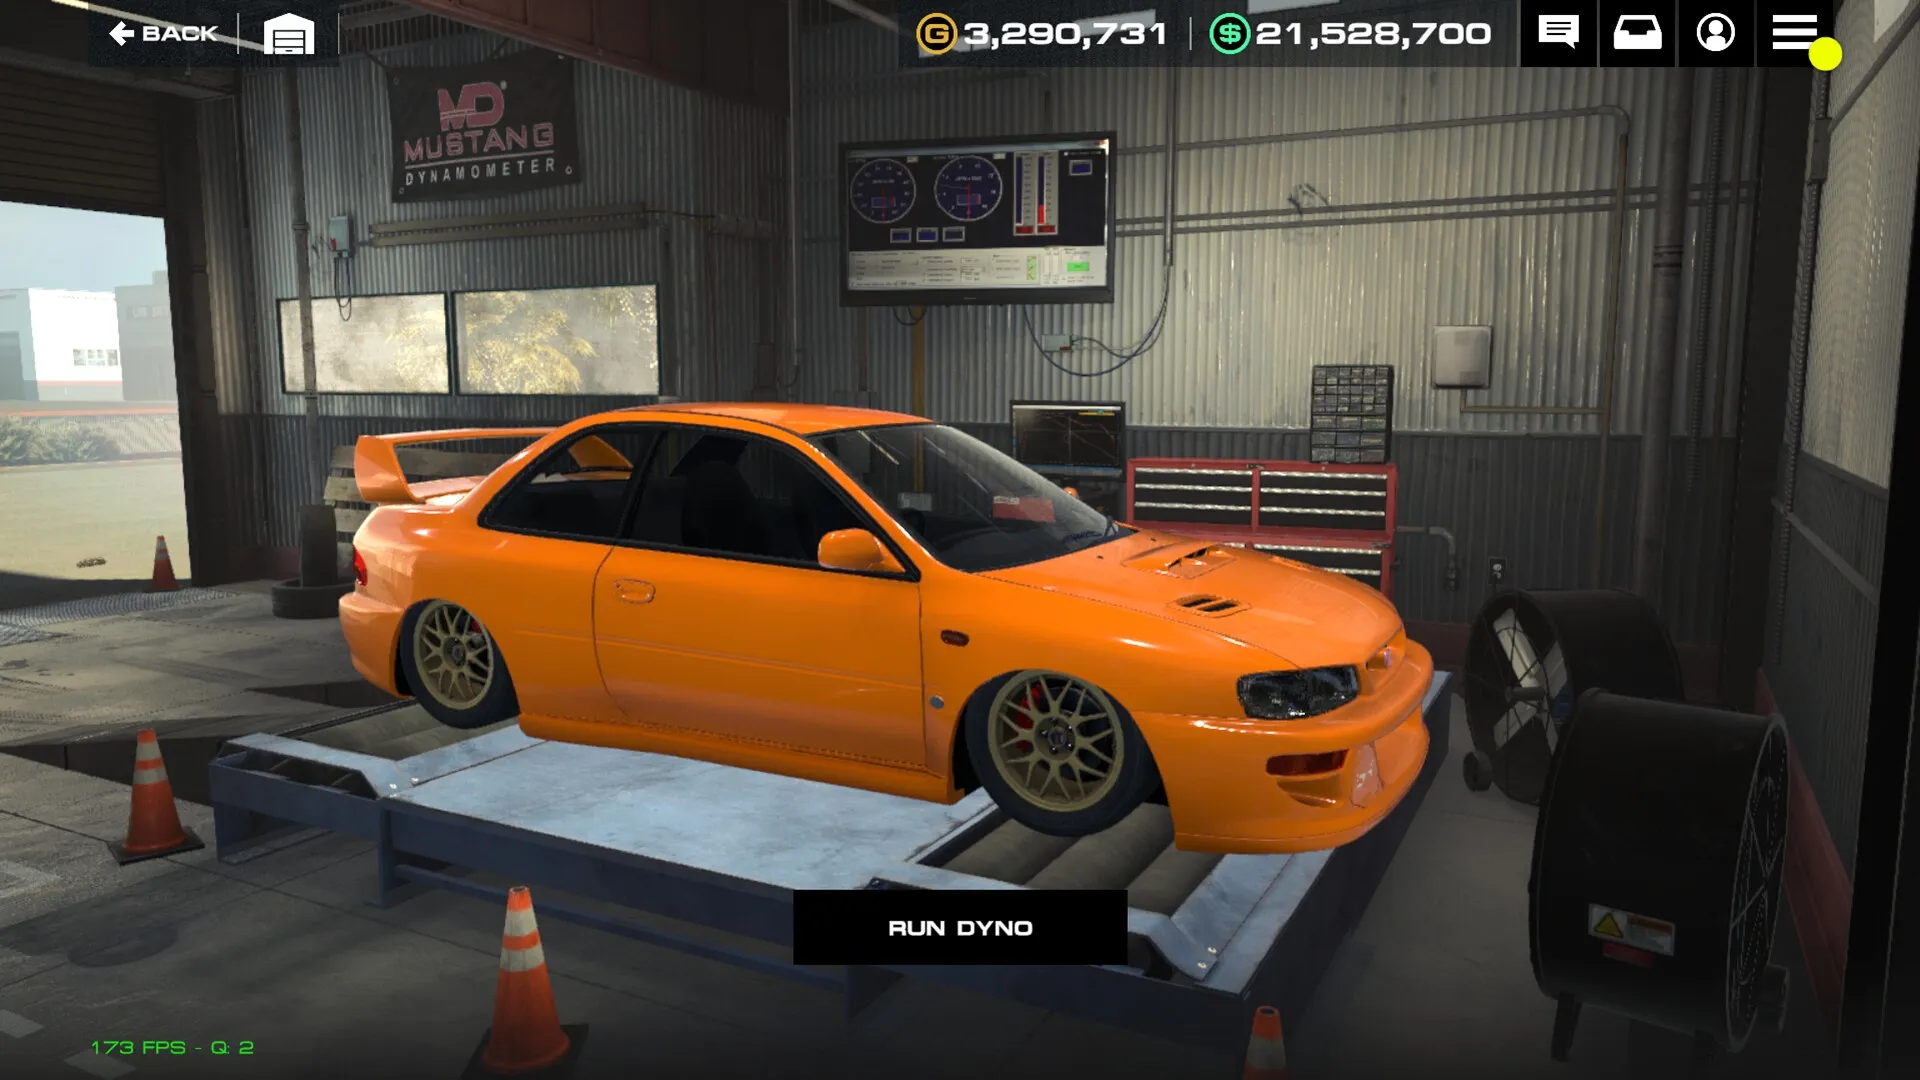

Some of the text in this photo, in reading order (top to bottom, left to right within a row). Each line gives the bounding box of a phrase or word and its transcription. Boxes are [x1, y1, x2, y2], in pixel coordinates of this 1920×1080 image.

[437, 81, 505, 132] MD
[403, 122, 554, 162] MUSTANG
[405, 157, 555, 186] DYNAMOMETER
